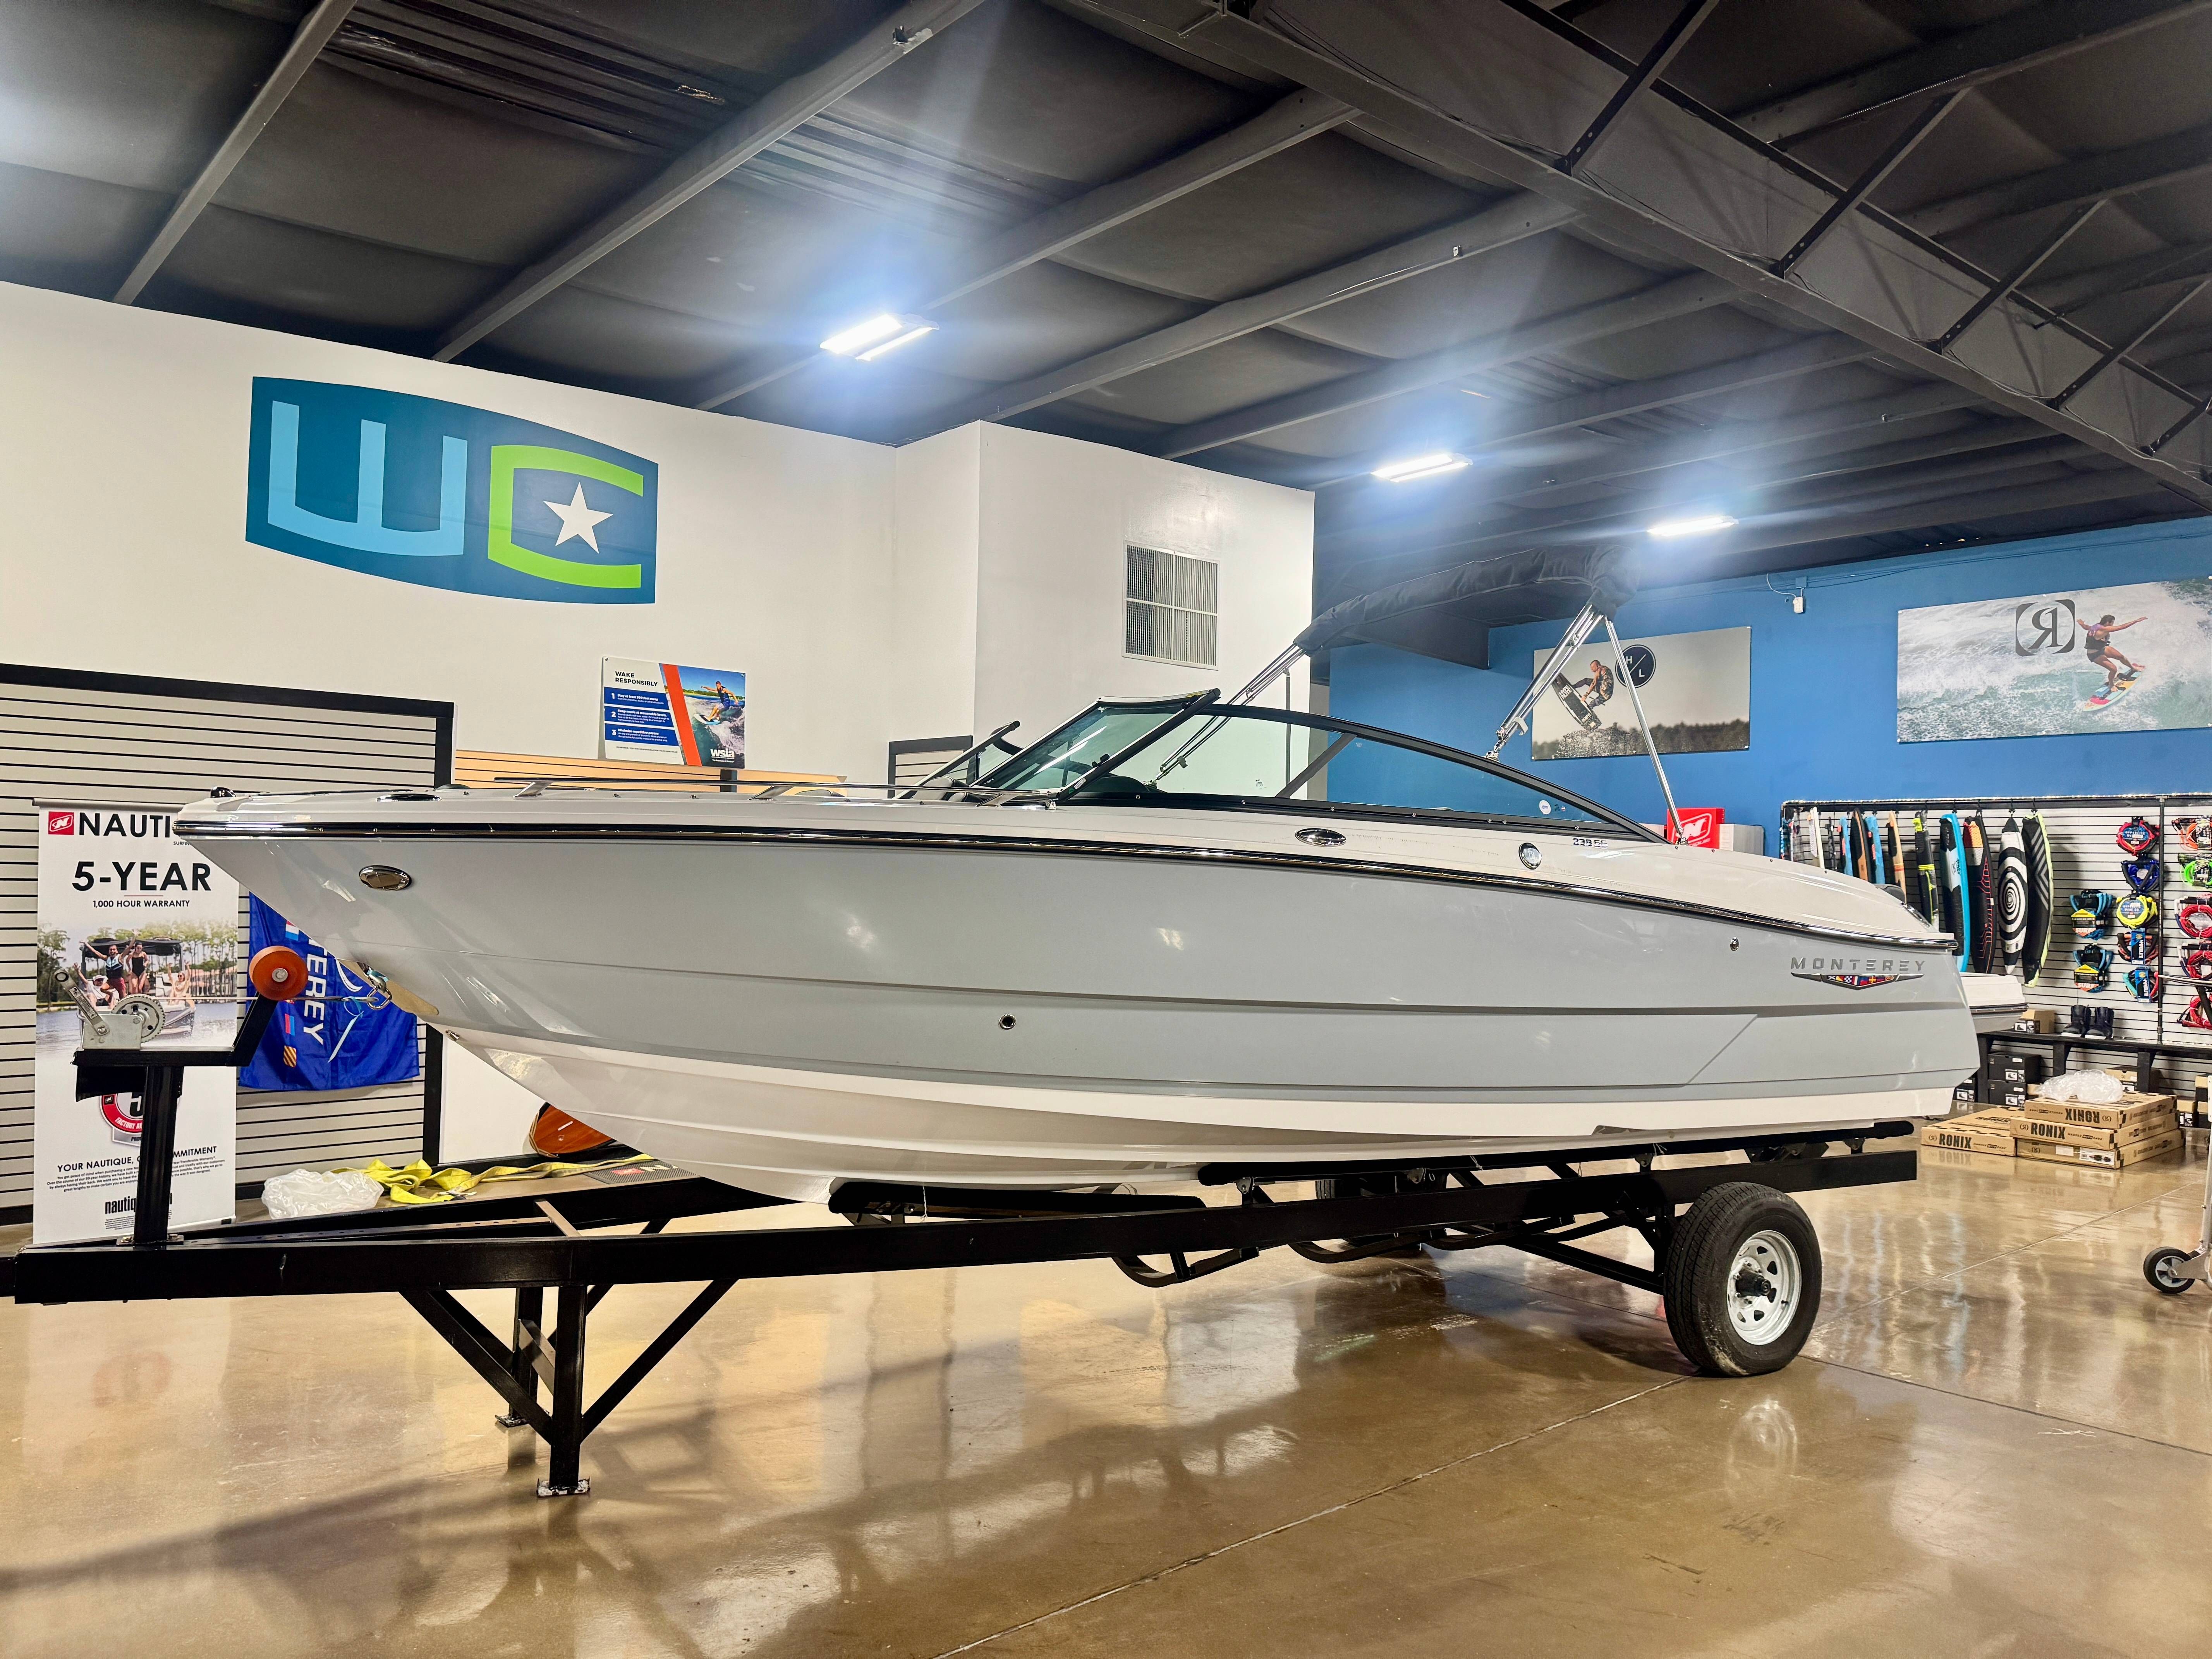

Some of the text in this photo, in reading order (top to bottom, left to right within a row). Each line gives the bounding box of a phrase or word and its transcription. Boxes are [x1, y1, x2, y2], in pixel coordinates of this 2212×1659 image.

[1639, 669, 1645, 677] L
[615, 677, 658, 687] RESPONSIBLY
[79, 812, 170, 838] NAUTI
[72, 860, 211, 892] 5-YEAR
[93, 900, 114, 908] 1,000
[1790, 957, 1925, 971] MONTEREY
[2065, 1108, 2100, 1124] RONIX
[2031, 1122, 2066, 1139] RONIX
[1939, 1133, 1972, 1149] RONIX
[57, 1163, 83, 1173] YOUR
[86, 1156, 134, 1170] NAUTIQUE,
[173, 1146, 217, 1158] MMITMENT
